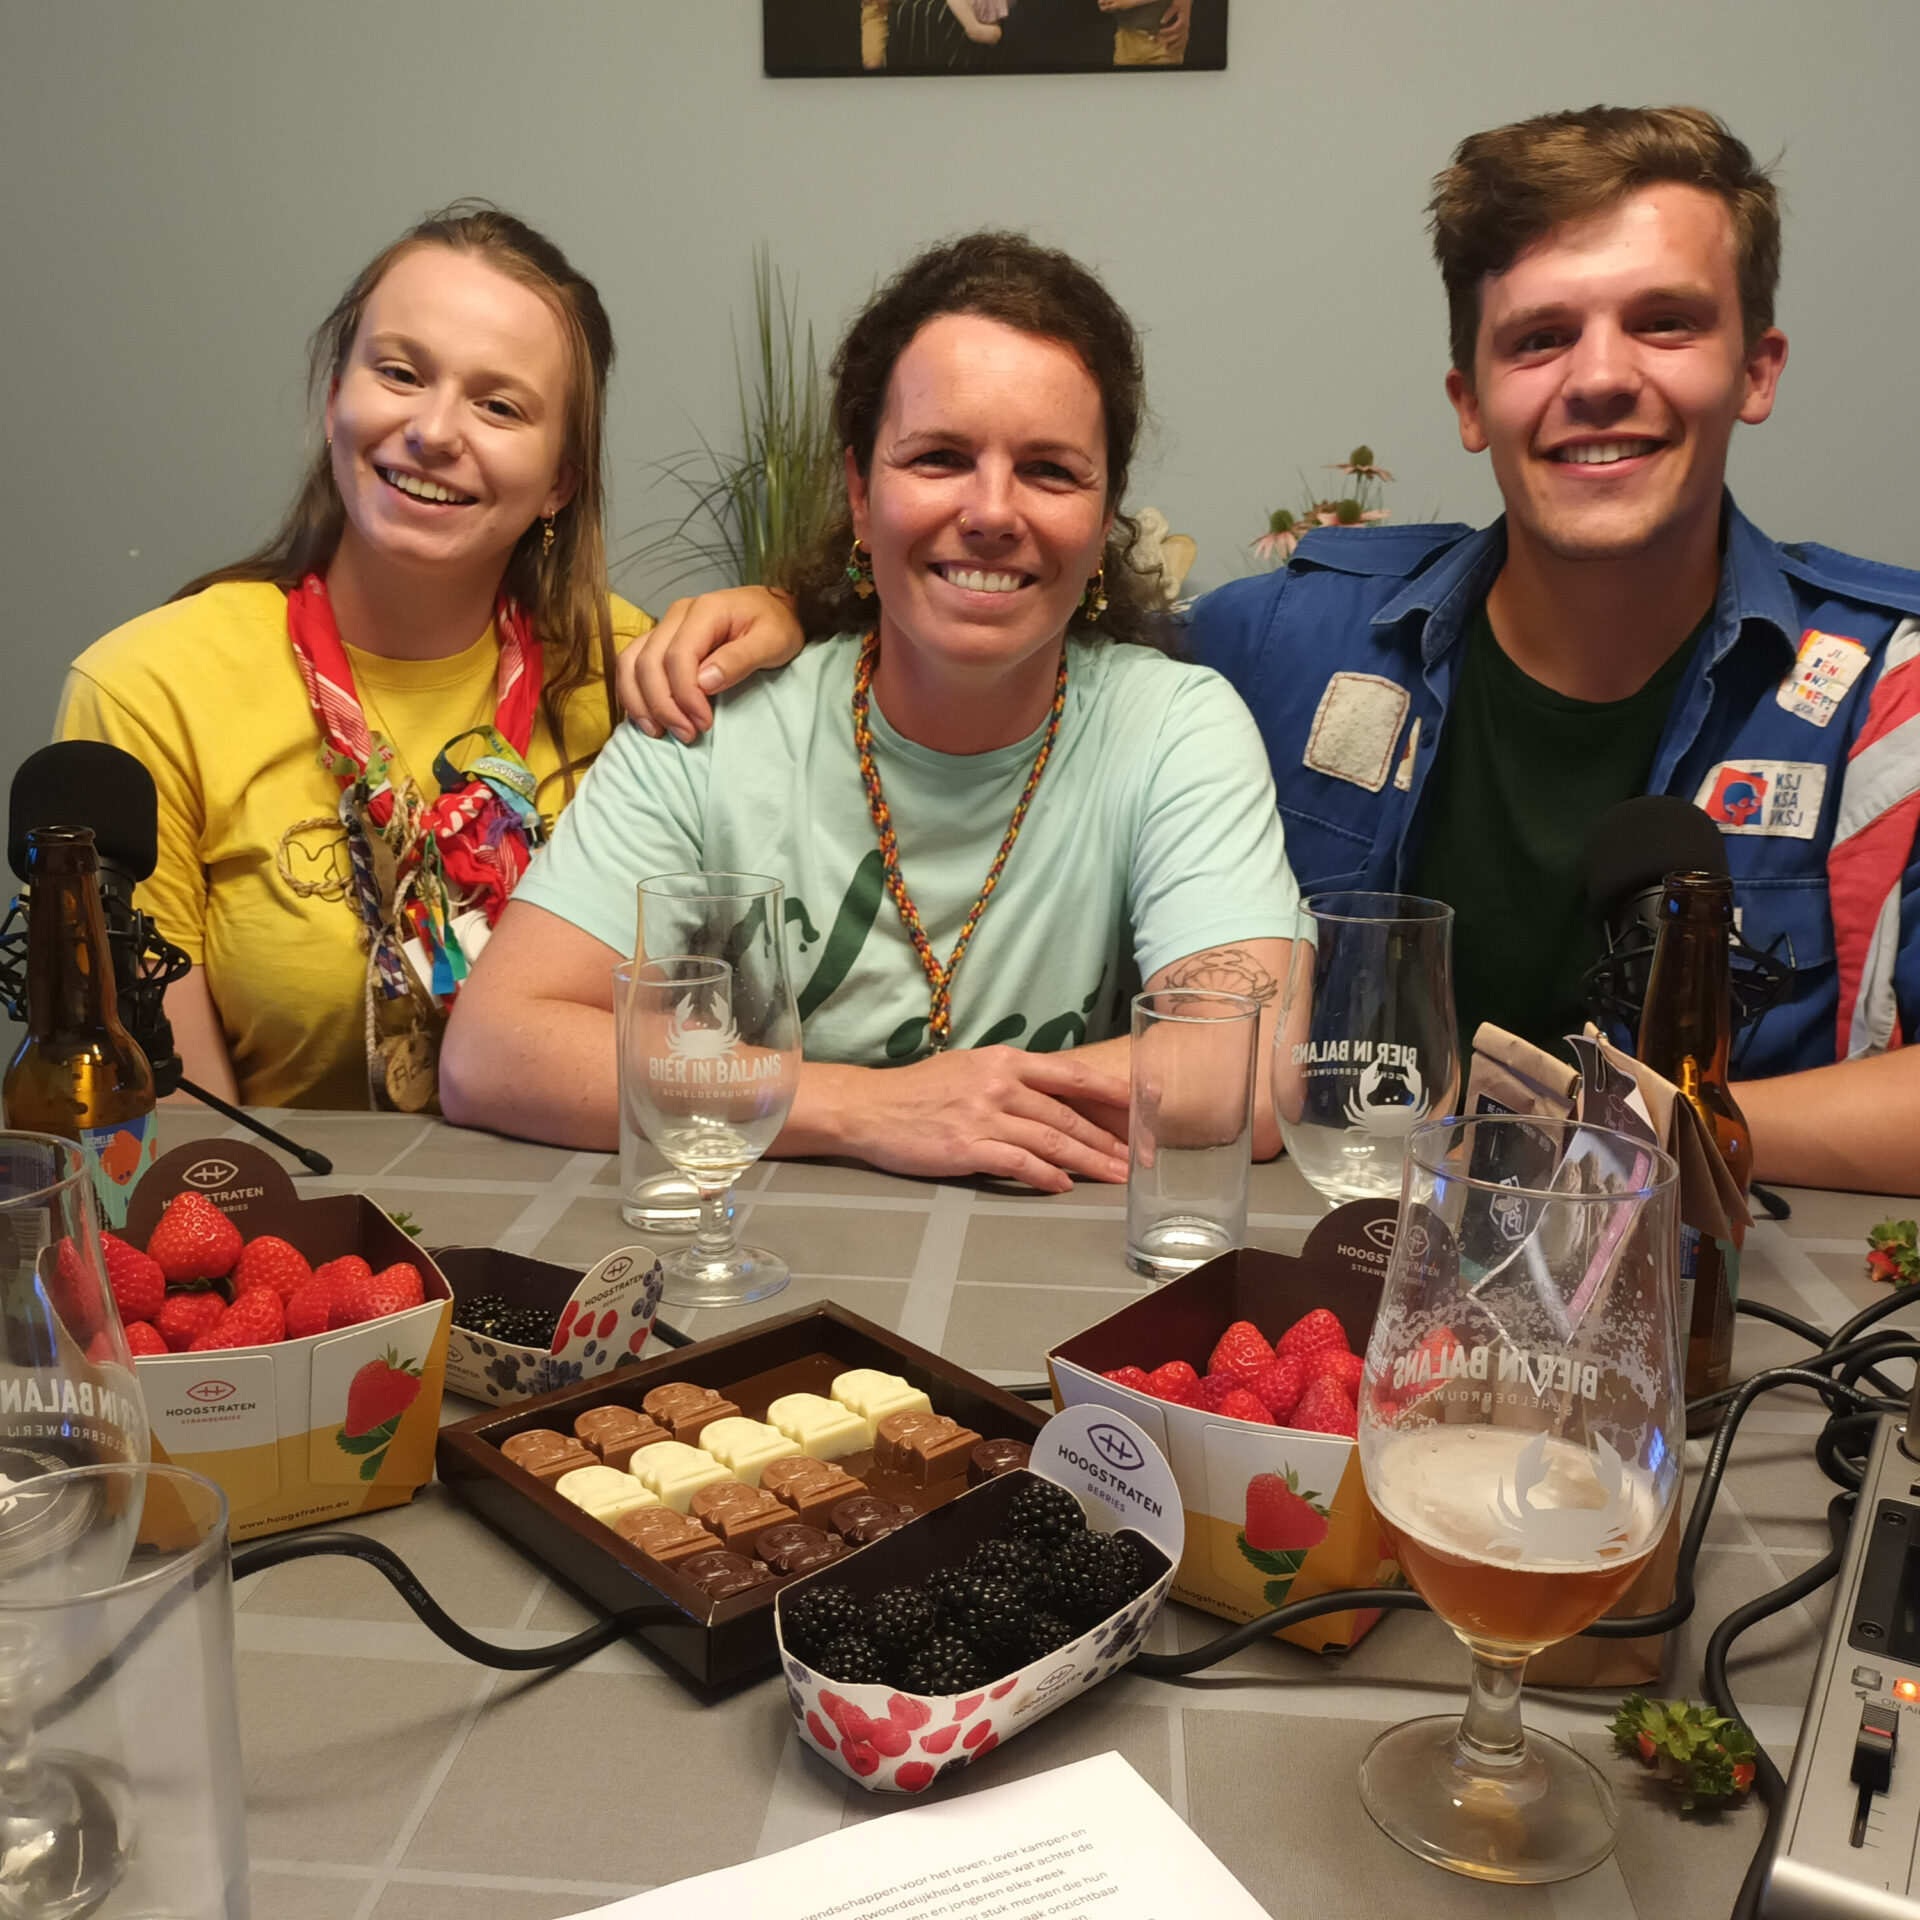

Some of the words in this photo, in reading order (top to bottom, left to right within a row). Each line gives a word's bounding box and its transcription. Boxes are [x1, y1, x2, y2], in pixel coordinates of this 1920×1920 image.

[1775, 773, 1802, 791] KSJ
[1772, 791, 1798, 809] KSA
[649, 1057, 687, 1083] BIER
[692, 1061, 711, 1083] IN
[716, 1053, 782, 1083] BALANS
[162, 1186, 264, 1210] HSTRATEN
[584, 1272, 645, 1307] HOOGSTRATEN
[1727, 1400, 1739, 1417] LOW
[1769, 1368, 1832, 1385] MICROPHONE
[1838, 1385, 1867, 1404] CABLE
[166, 1402, 256, 1416] HOOGSTRATEN
[1058, 1444, 1163, 1518] HOOGSTRATEN
[1087, 1483, 1126, 1513] BERRIES
[239, 1500, 349, 1531] www.hoogstraten.eu
[1881, 1698, 1902, 1710] ON
[797, 1887, 899, 1920] riendschappen
[899, 1877, 928, 1891] voor
[930, 1868, 952, 1881] het
[952, 1858, 992, 1875] leven,
[993, 1850, 1019, 1864] over
[1020, 1833, 1070, 1855] kampen
[1070, 1827, 1087, 1839] en
[963, 1878, 979, 1890] en
[981, 1868, 1011, 1884] alles
[1012, 1861, 1035, 1874] wat
[1037, 1848, 1075, 1866] achter
[1078, 1841, 1094, 1853] de
[931, 1905, 947, 1917] en
[949, 1887, 1004, 1912] jongeren
[1006, 1878, 1032, 1894] elke
[1033, 1867, 1066, 1884] week
[981, 1904, 1010, 1919] stuk
[1010, 1886, 1061, 1909] mensen
[1062, 1880, 1083, 1893] die
[1082, 1870, 1108, 1885] hun
[1048, 1884, 1120, 1915] onzichtbaar
